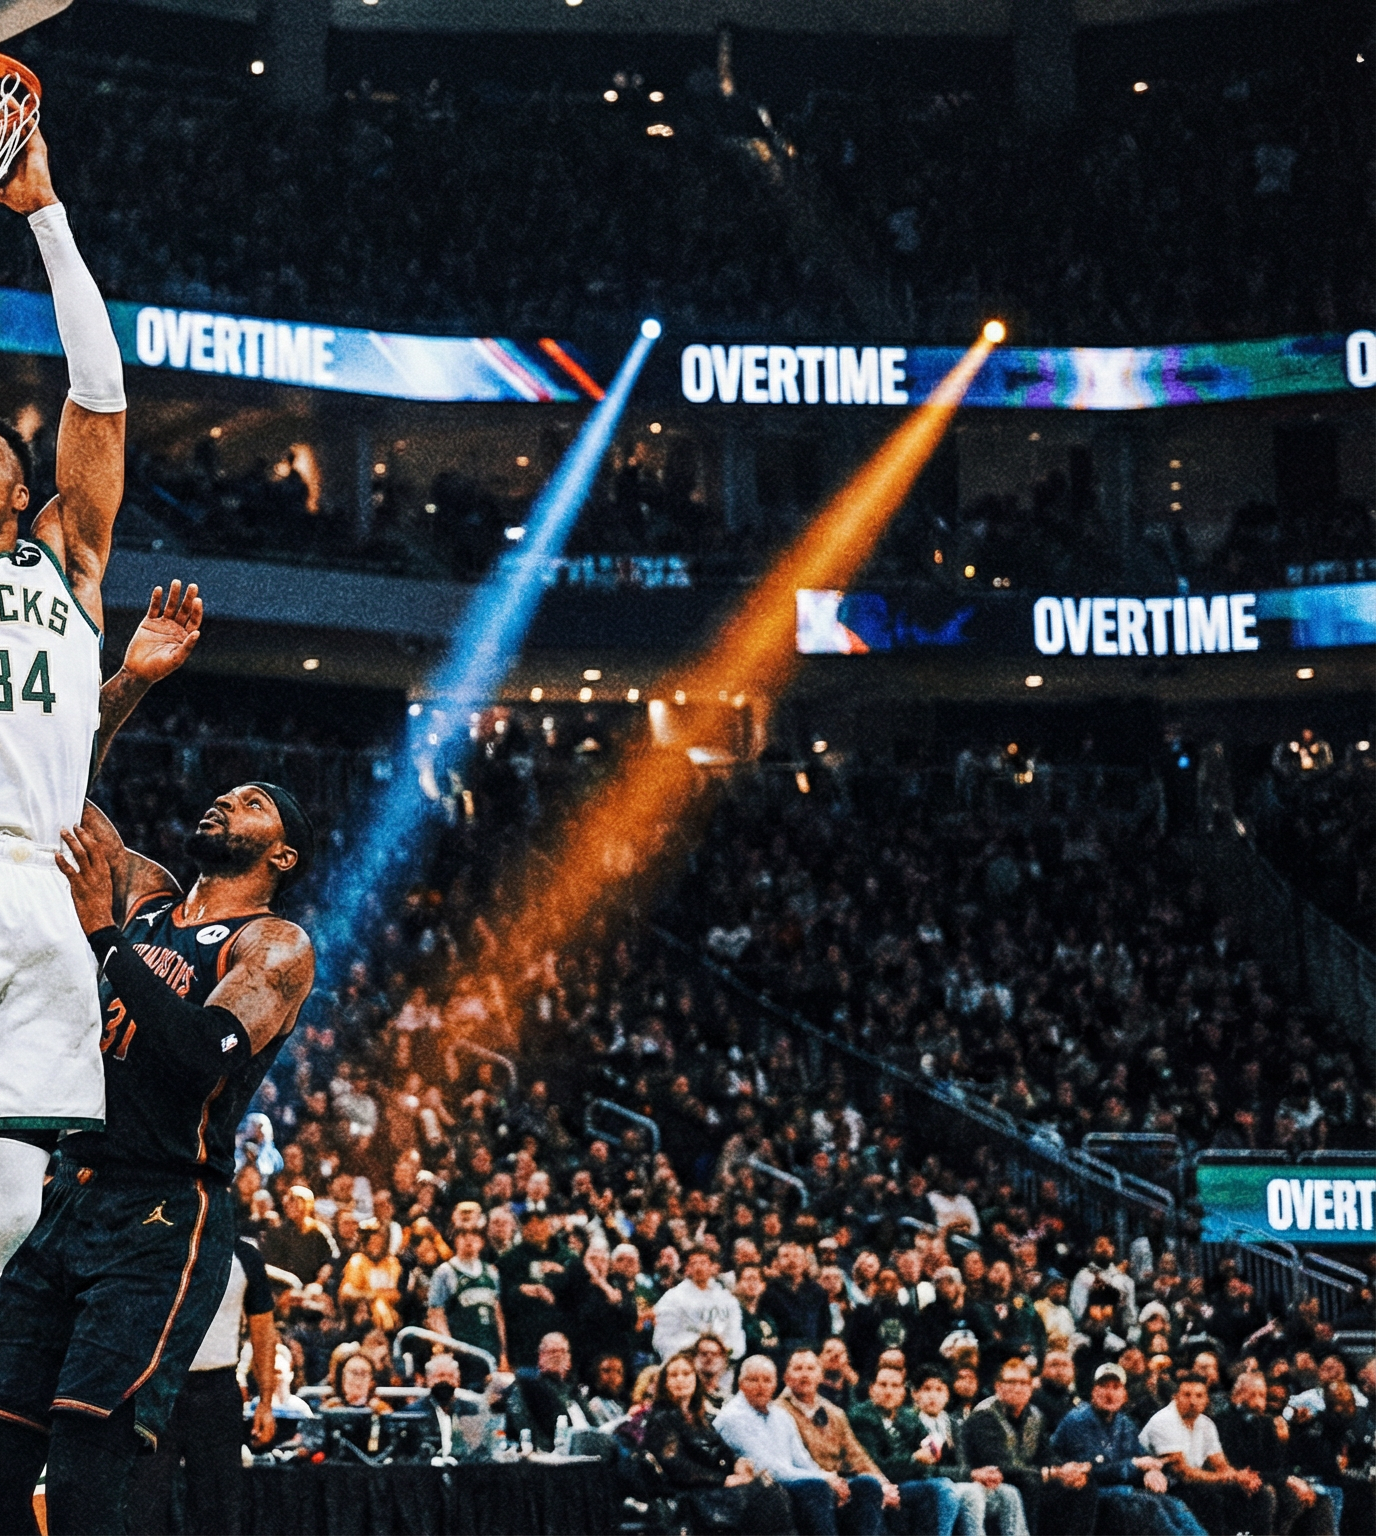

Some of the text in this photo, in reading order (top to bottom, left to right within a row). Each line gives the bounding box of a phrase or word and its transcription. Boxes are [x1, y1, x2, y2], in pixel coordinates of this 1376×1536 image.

[136, 306, 336, 385] OVERTIME
[680, 343, 909, 405] OVERTIME
[1033, 594, 1259, 656] OVERTIME
[99, 997, 137, 1060] 31
[1266, 1178, 1376, 1230] OVERT
